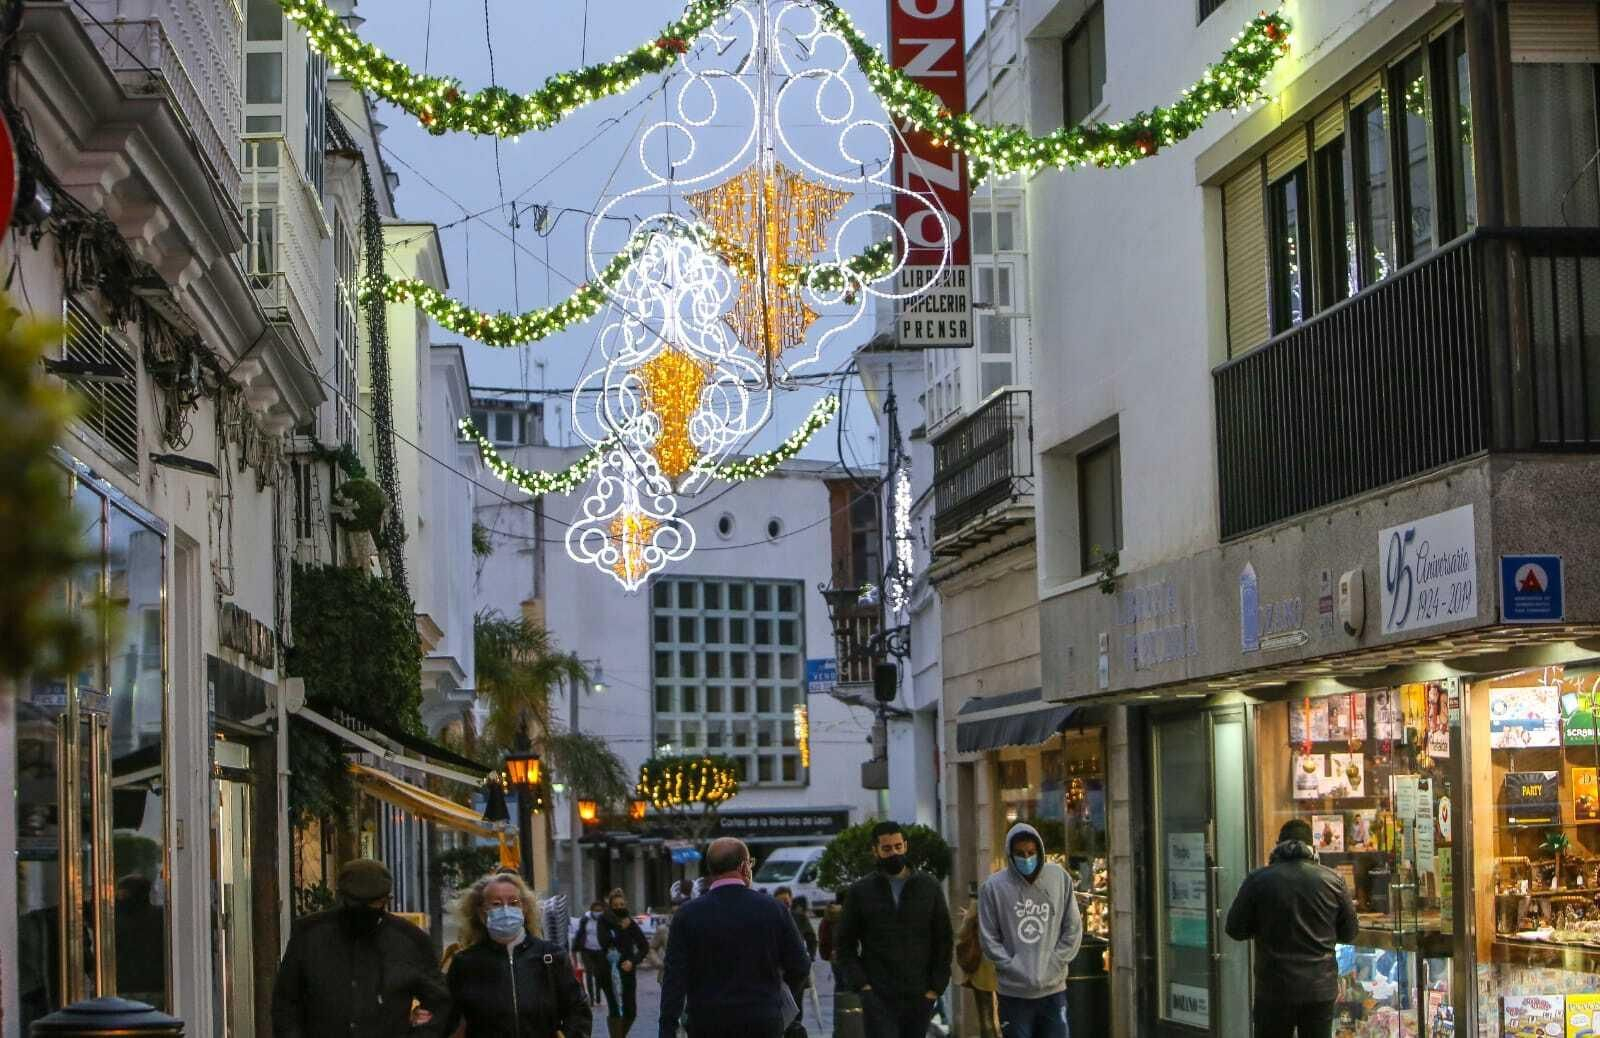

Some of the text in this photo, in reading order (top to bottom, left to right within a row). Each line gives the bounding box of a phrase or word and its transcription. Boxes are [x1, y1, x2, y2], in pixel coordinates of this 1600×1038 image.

[903, 294, 966, 313] PAPELERIA
[903, 319, 967, 338] PRENSA
[1386, 527, 1415, 630] 95
[1416, 540, 1470, 584] Aniversario
[1521, 783, 1543, 797] PARTY
